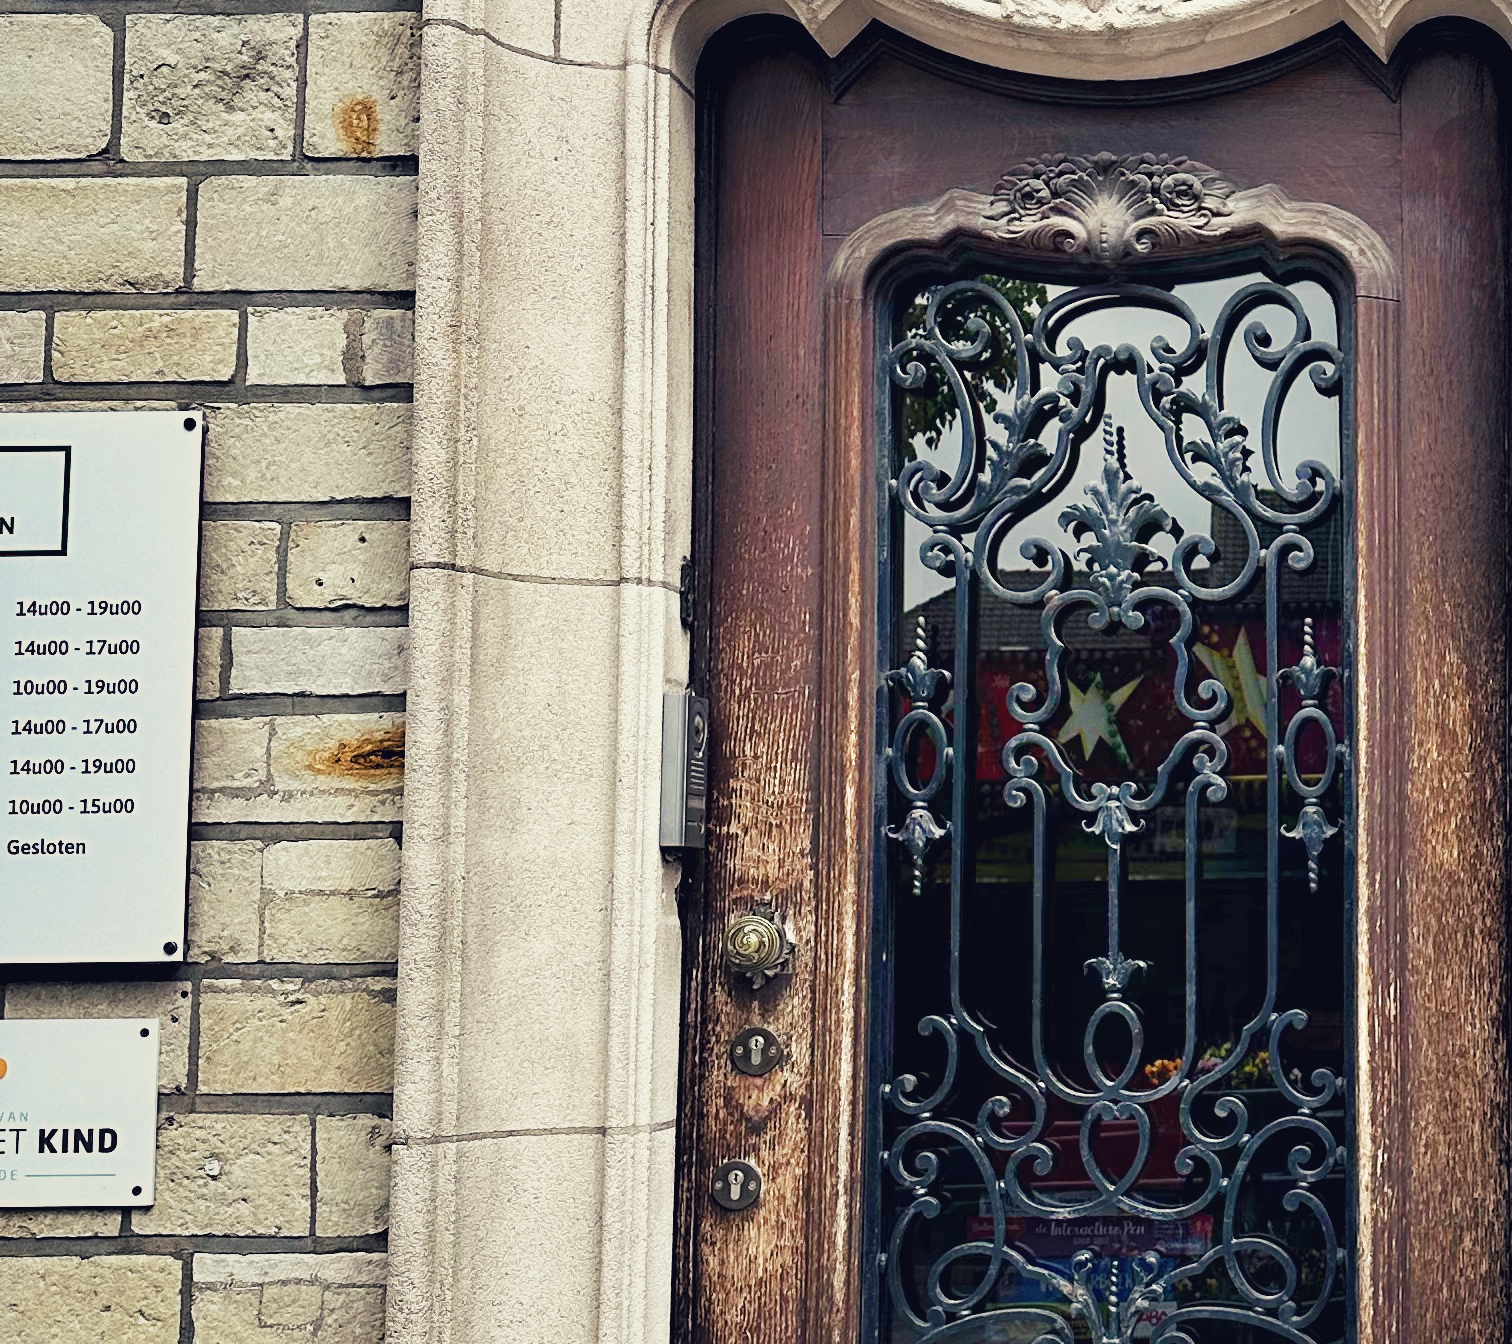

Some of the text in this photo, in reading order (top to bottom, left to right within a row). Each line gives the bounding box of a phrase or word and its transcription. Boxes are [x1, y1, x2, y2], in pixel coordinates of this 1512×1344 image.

[15, 600, 70, 617] 14u00
[86, 599, 142, 616] 19u00
[14, 640, 69, 657] 14u00
[85, 639, 141, 656] 17u00
[12, 679, 67, 696] 10u00
[83, 678, 139, 695] 19u00
[10, 719, 65, 736] 14u00
[82, 718, 138, 735] 17u00
[9, 759, 64, 776] 14u00
[80, 758, 136, 775] 19u00
[8, 799, 63, 816] 10u00
[79, 798, 135, 815] 15u00
[6, 838, 86, 856] Gesloten
[38, 1128, 118, 1154] KIND
